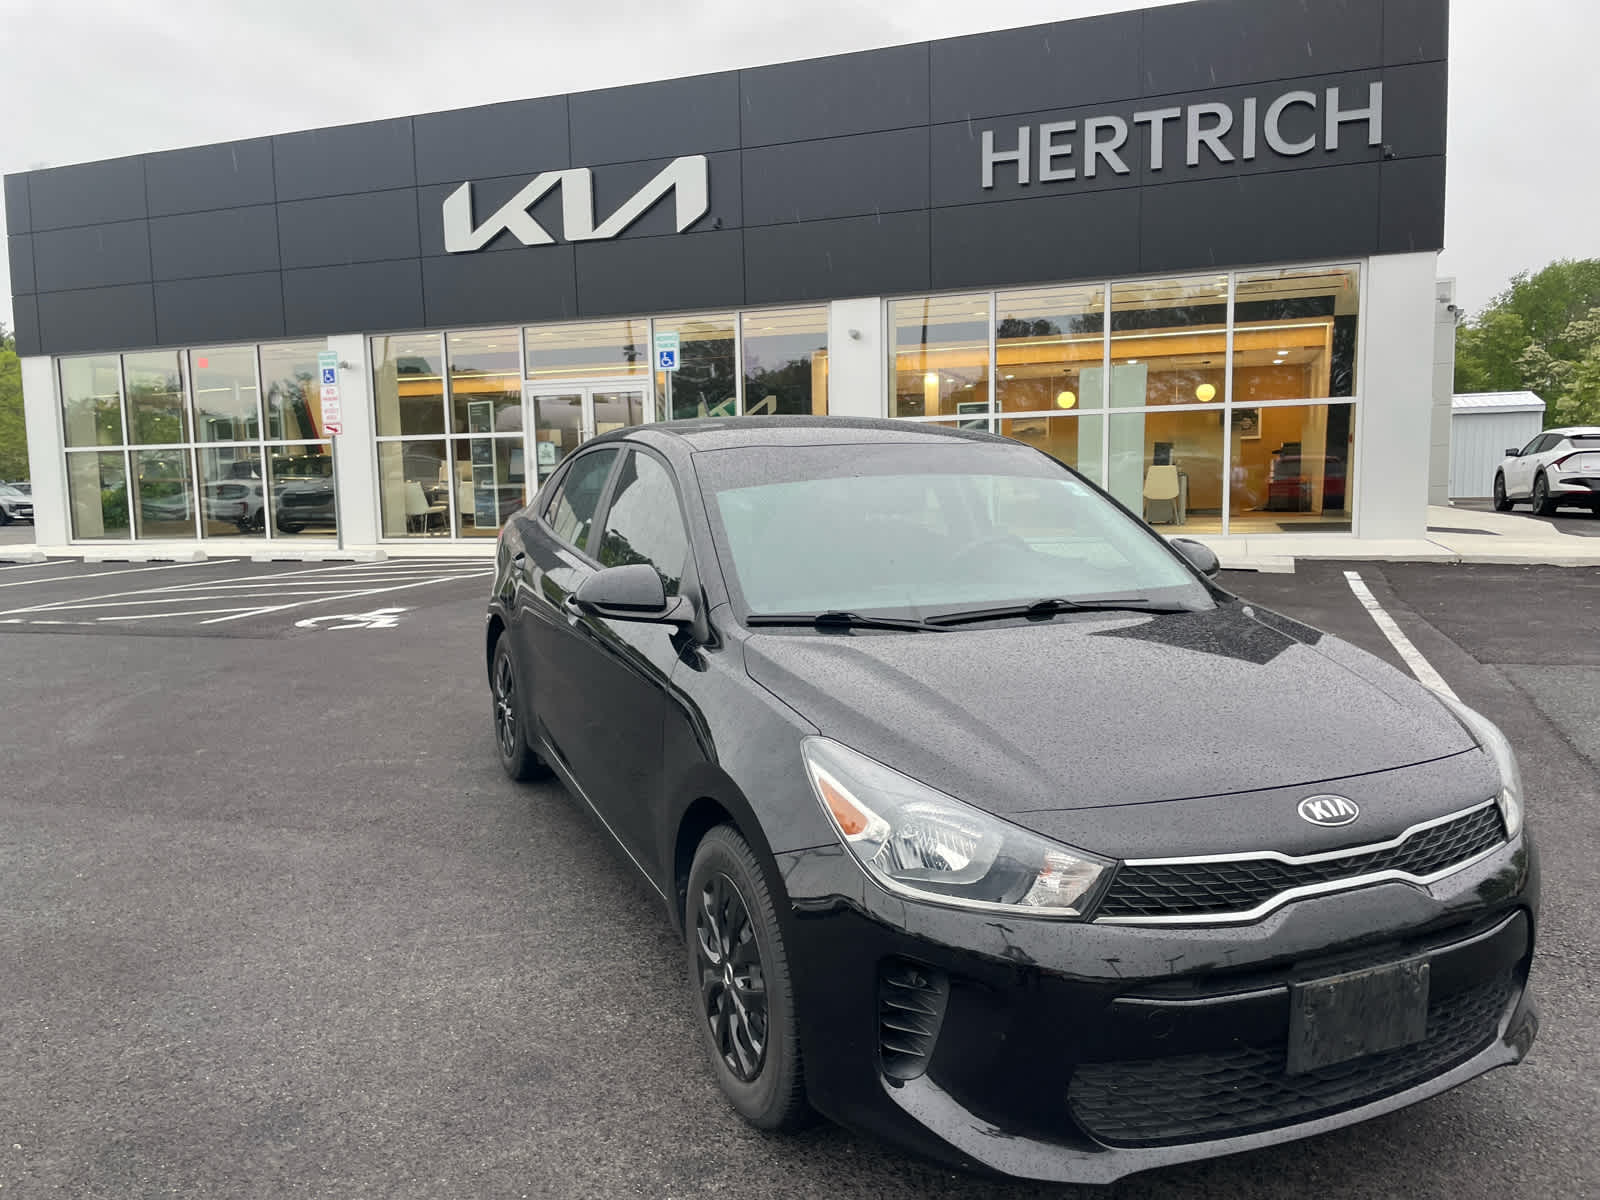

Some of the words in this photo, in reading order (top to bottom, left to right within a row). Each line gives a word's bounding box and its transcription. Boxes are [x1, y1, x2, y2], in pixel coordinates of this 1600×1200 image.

[981, 81, 1384, 189] HERTRICH
[442, 154, 709, 253] KIA
[1304, 798, 1355, 820] KIA
